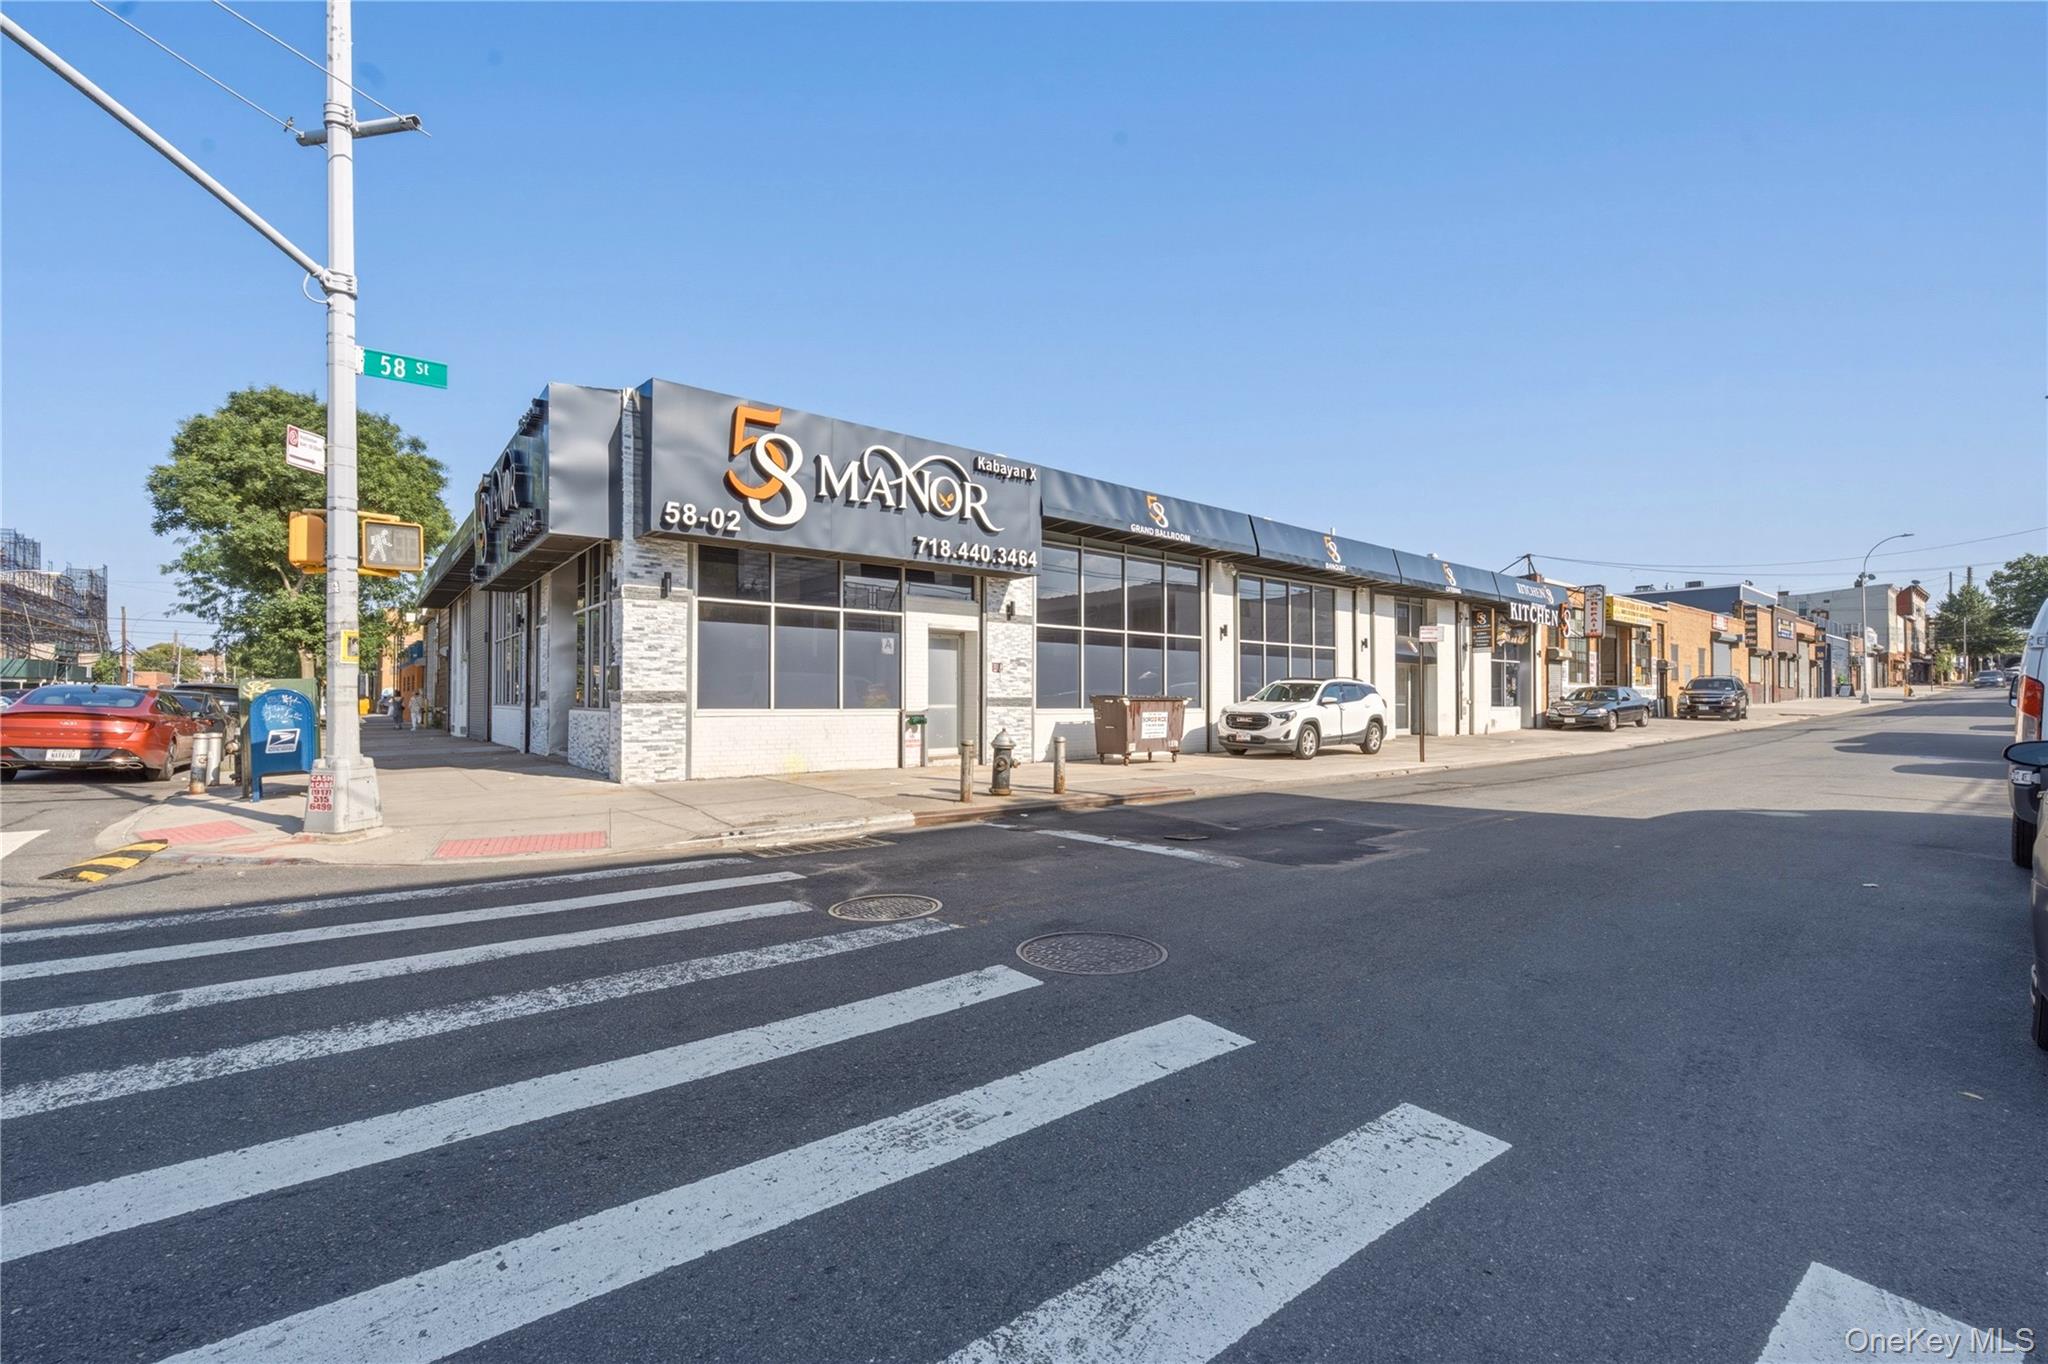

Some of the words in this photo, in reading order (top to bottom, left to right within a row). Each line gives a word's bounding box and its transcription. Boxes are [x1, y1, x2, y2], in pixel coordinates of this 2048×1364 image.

[380, 355, 405, 378] 58
[415, 362, 429, 376] St
[727, 404, 807, 526] 58
[815, 445, 1006, 532] MANOR
[977, 456, 1027, 480] Kabayan
[1029, 467, 1037, 480] X
[664, 501, 741, 531] 58-02
[1146, 495, 1169, 528] 58
[1130, 523, 1154, 535] GRAND
[1154, 528, 1191, 542] BALLROOM
[916, 535, 1038, 568] 718.440.3464
[1323, 535, 1341, 563] 58
[1510, 602, 1558, 627] KITCHEN
[1590, 601, 1598, 633] REPAIR
